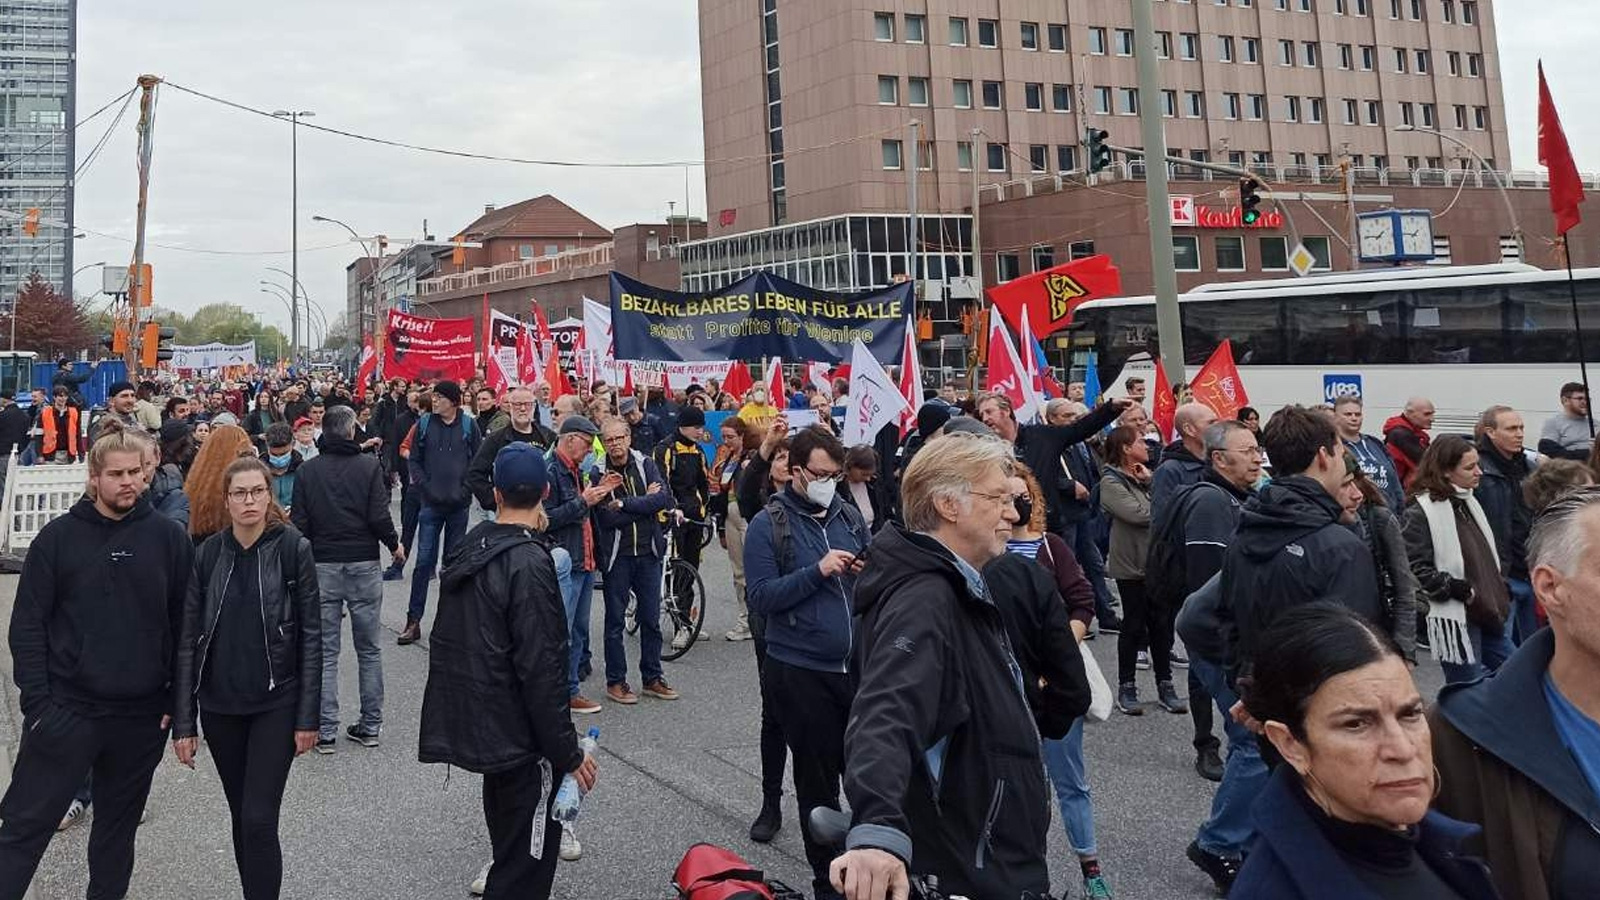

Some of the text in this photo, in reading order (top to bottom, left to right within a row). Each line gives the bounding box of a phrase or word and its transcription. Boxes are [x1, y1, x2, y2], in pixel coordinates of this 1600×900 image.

[1195, 206, 1284, 228] Kaufnd
[620, 293, 903, 320] BEZAHLBARES LEBEN FÜR ALLE
[705, 318, 770, 341] Profite
